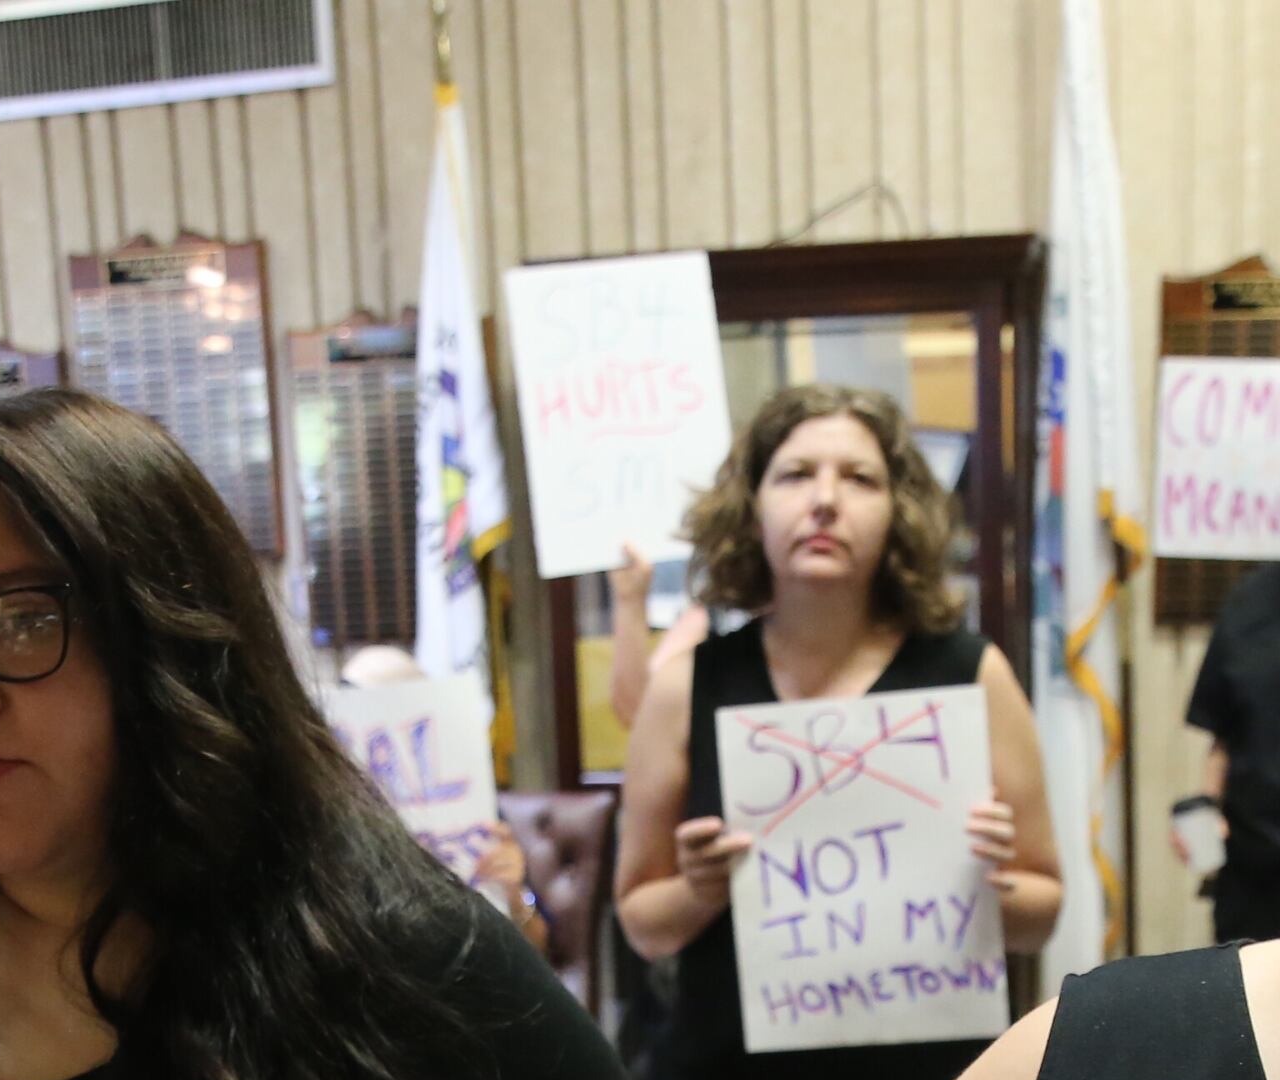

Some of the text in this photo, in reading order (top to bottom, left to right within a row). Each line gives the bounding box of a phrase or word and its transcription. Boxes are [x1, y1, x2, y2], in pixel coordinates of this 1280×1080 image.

[535, 357, 708, 440] HURTS
[734, 700, 951, 817] SB4
[758, 820, 907, 908] NOT
[758, 893, 980, 961] IN MY
[760, 957, 1005, 1026] HOMETOWN
